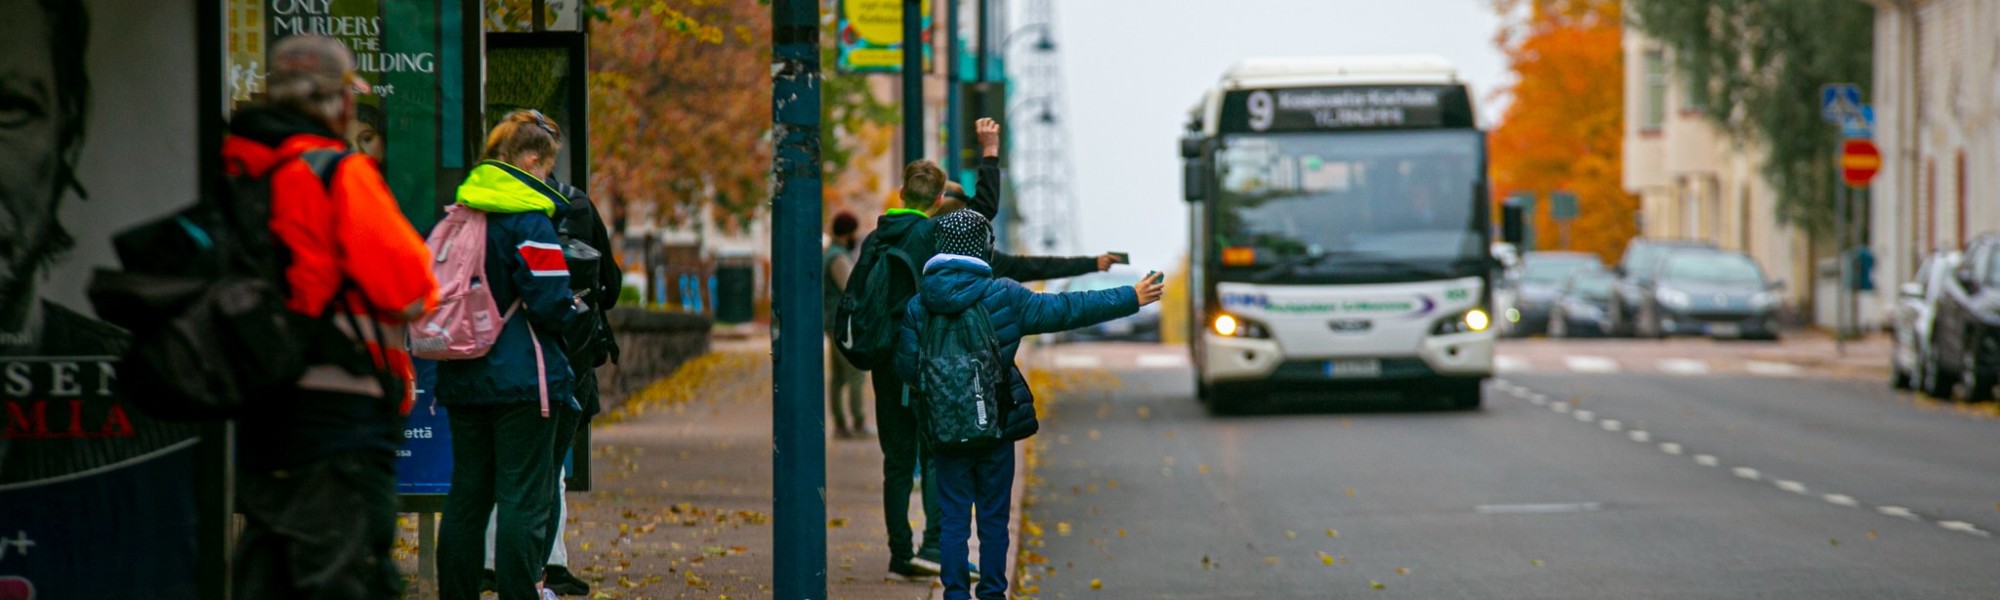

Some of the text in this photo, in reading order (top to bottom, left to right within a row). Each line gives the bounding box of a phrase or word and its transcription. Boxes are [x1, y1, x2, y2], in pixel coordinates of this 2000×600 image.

[272, 0, 332, 15] ONLY
[273, 16, 382, 36] MURDERS
[351, 37, 381, 51] THE
[372, 83, 395, 97] nyt
[1247, 90, 1275, 132] 9
